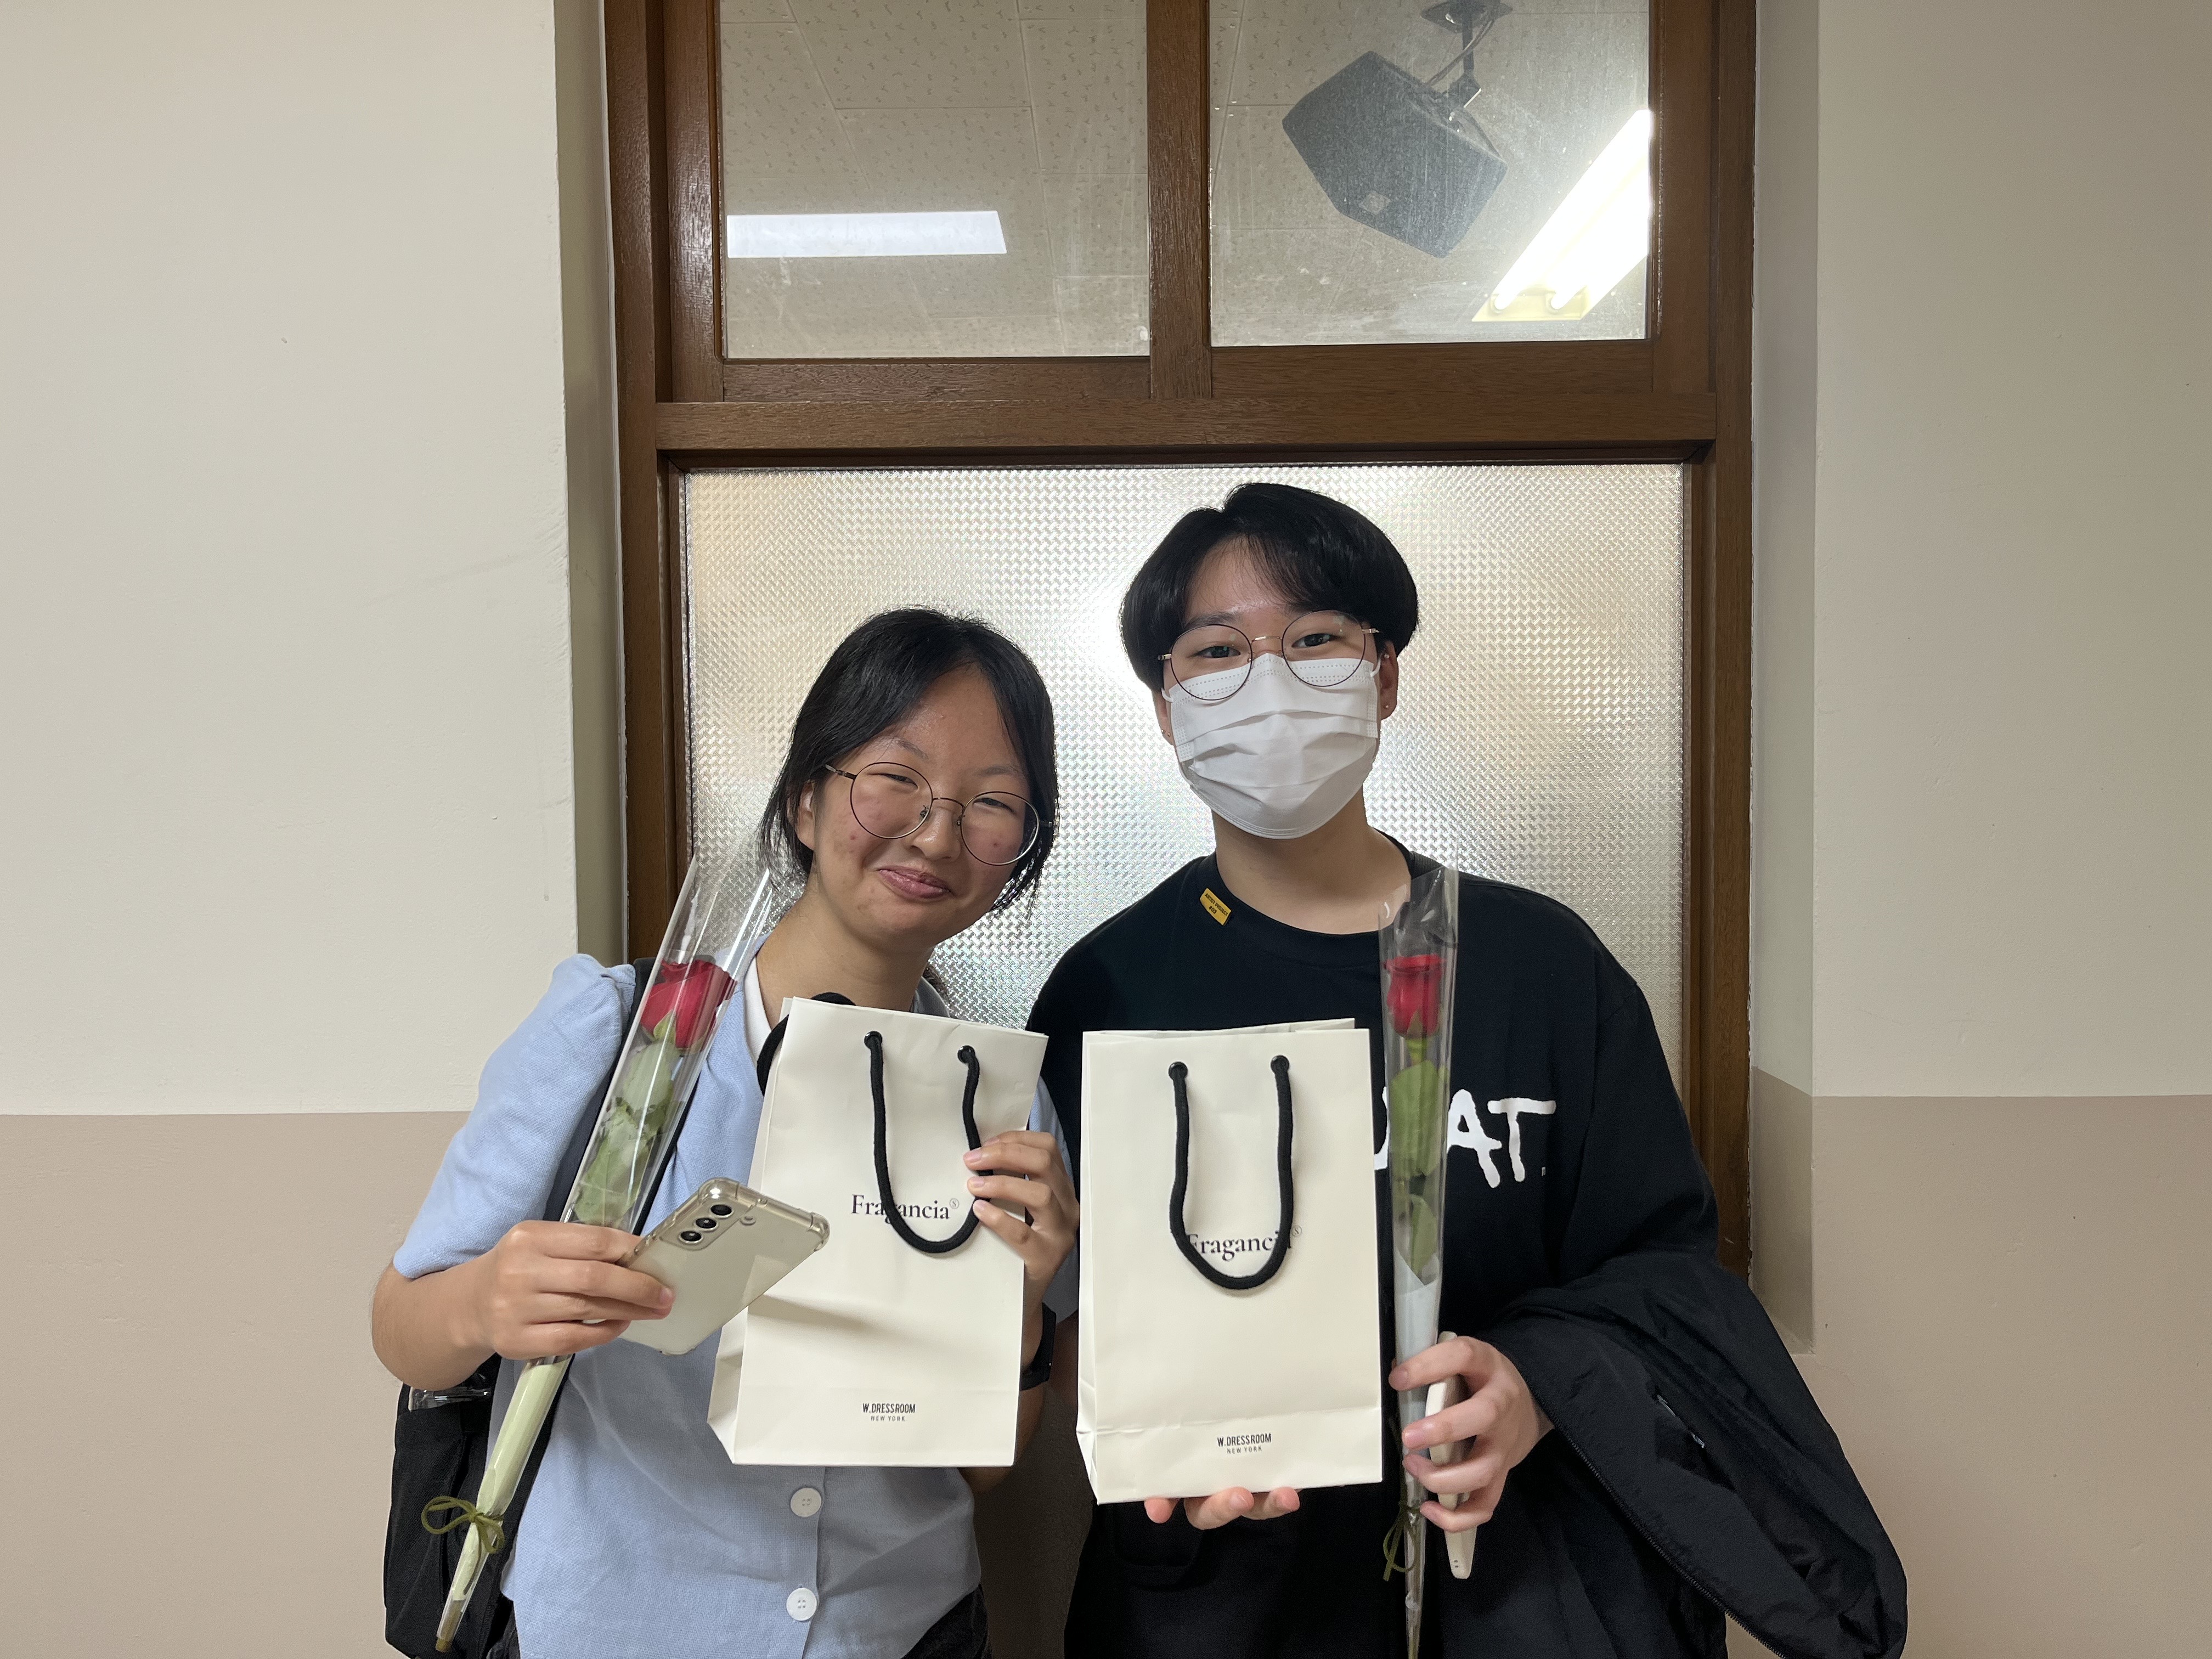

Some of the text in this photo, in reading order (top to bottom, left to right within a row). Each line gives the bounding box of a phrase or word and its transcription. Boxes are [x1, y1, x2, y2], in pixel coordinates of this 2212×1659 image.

[851, 1194, 950, 1224] Fraancia
[862, 1403, 916, 1414] W.DRESSROOM
[1217, 1432, 1272, 1447] W.DRESSROOM
